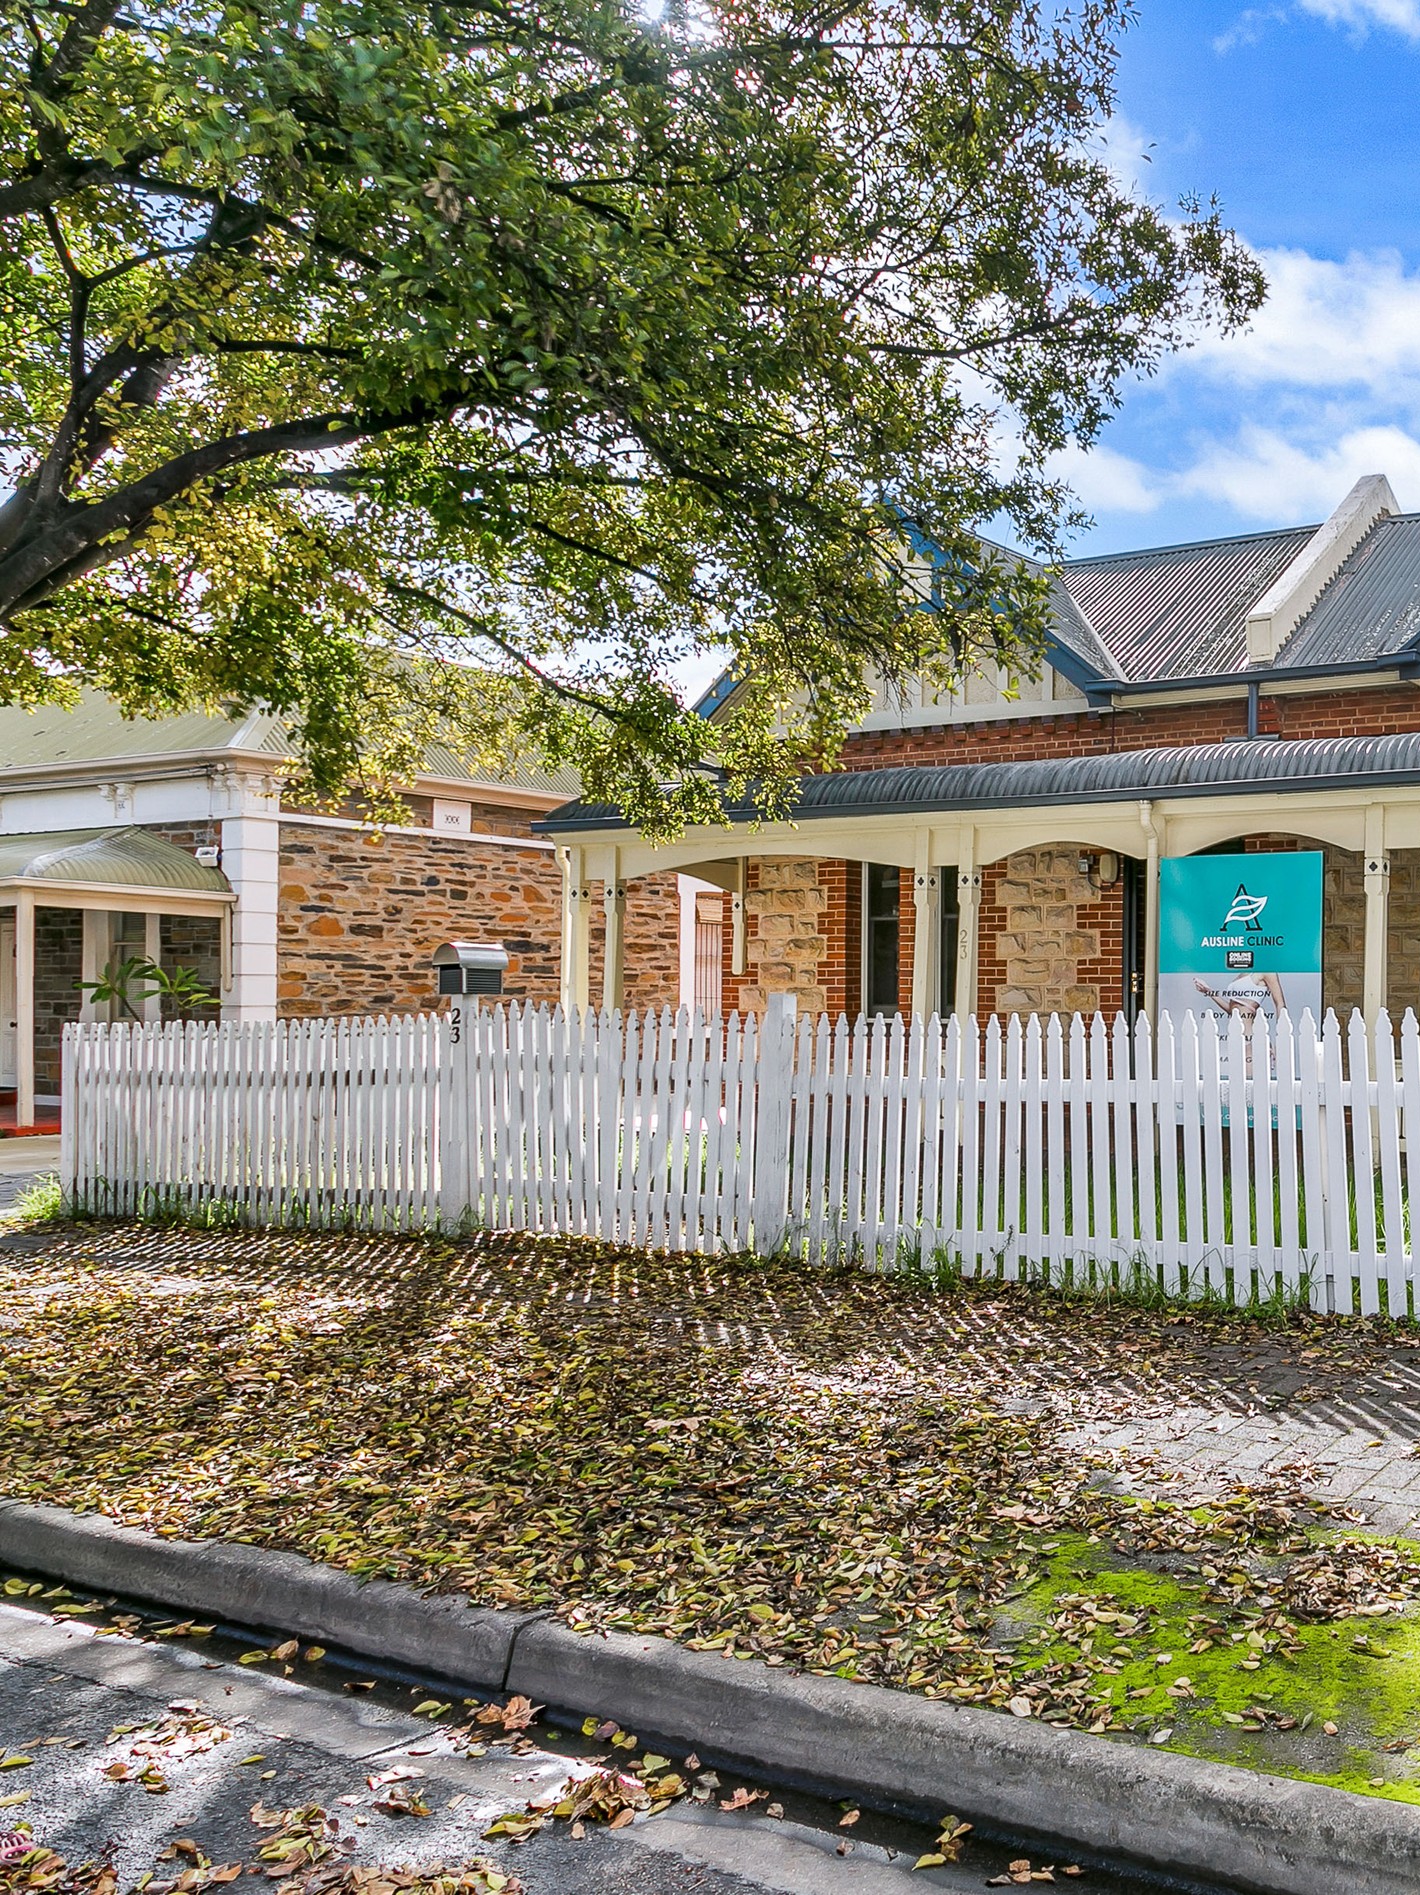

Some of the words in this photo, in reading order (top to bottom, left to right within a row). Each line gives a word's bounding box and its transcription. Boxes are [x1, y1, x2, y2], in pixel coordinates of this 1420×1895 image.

[1201, 936, 1245, 947] AUSLINE
[1247, 935, 1284, 946] CLINIC
[451, 1008, 461, 1044] 23
